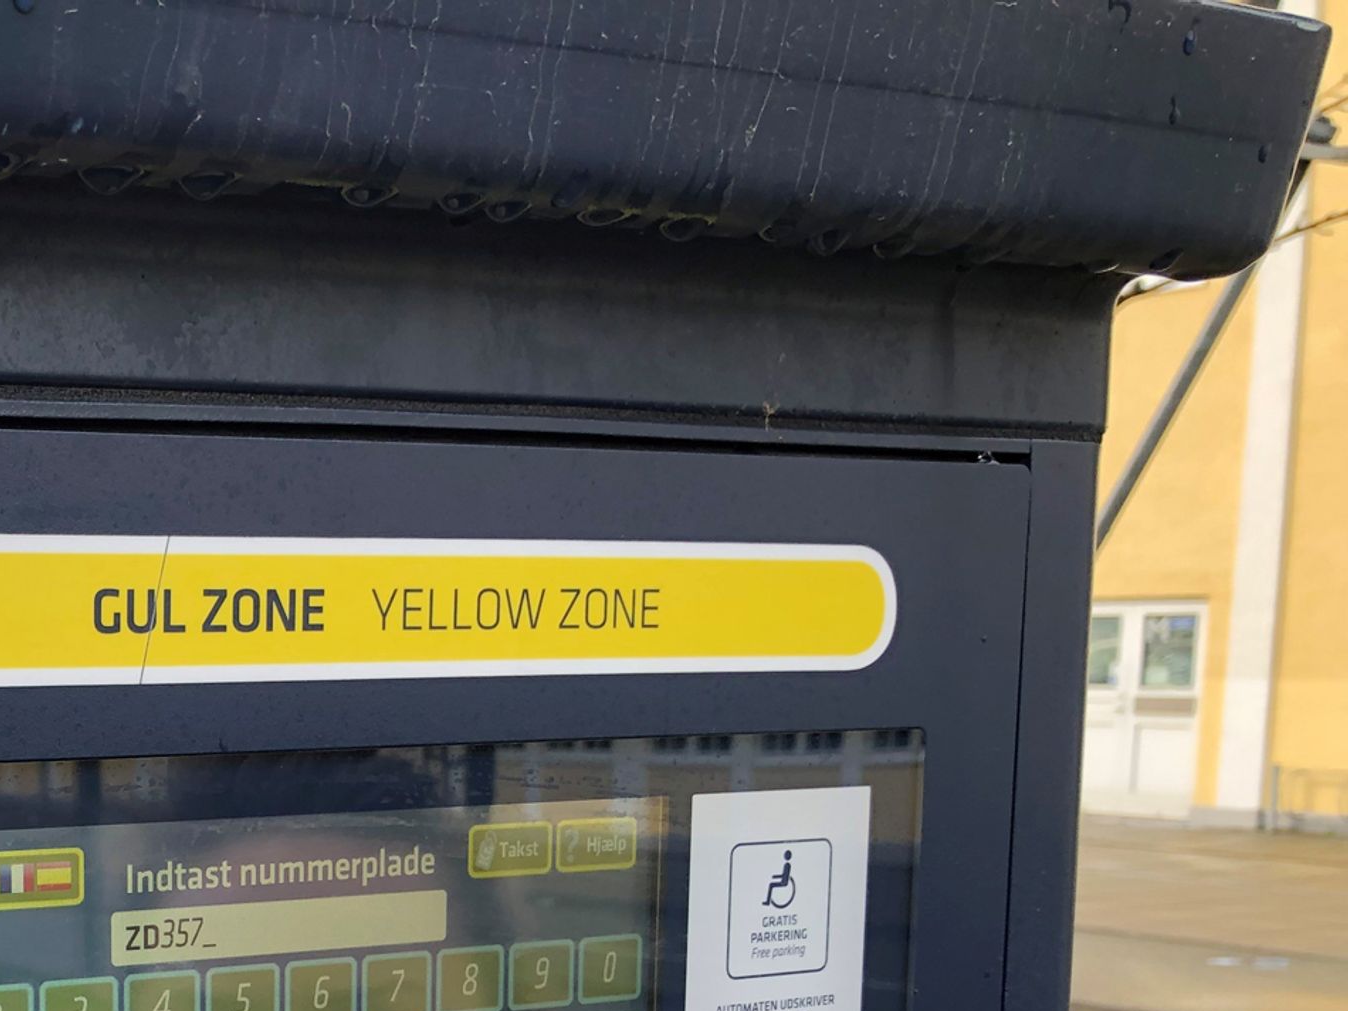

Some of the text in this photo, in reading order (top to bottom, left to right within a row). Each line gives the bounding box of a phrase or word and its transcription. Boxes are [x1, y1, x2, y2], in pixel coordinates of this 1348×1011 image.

[93, 587, 661, 634] GUL ZONE YELLOW ZONE
[499, 840, 539, 859] Takst
[586, 835, 627, 856] Hjælp
[126, 846, 435, 894] Indtast nummerplade
[762, 914, 798, 928] GRATIS
[750, 928, 808, 943] PARKERING
[750, 944, 807, 960] Free parking
[313, 976, 331, 1009] 6
[390, 969, 405, 1003] 7
[462, 963, 479, 997] 8
[534, 957, 550, 990] 9
[602, 951, 617, 984] 0
[780, 994, 835, 1010] UDSKRIVER
